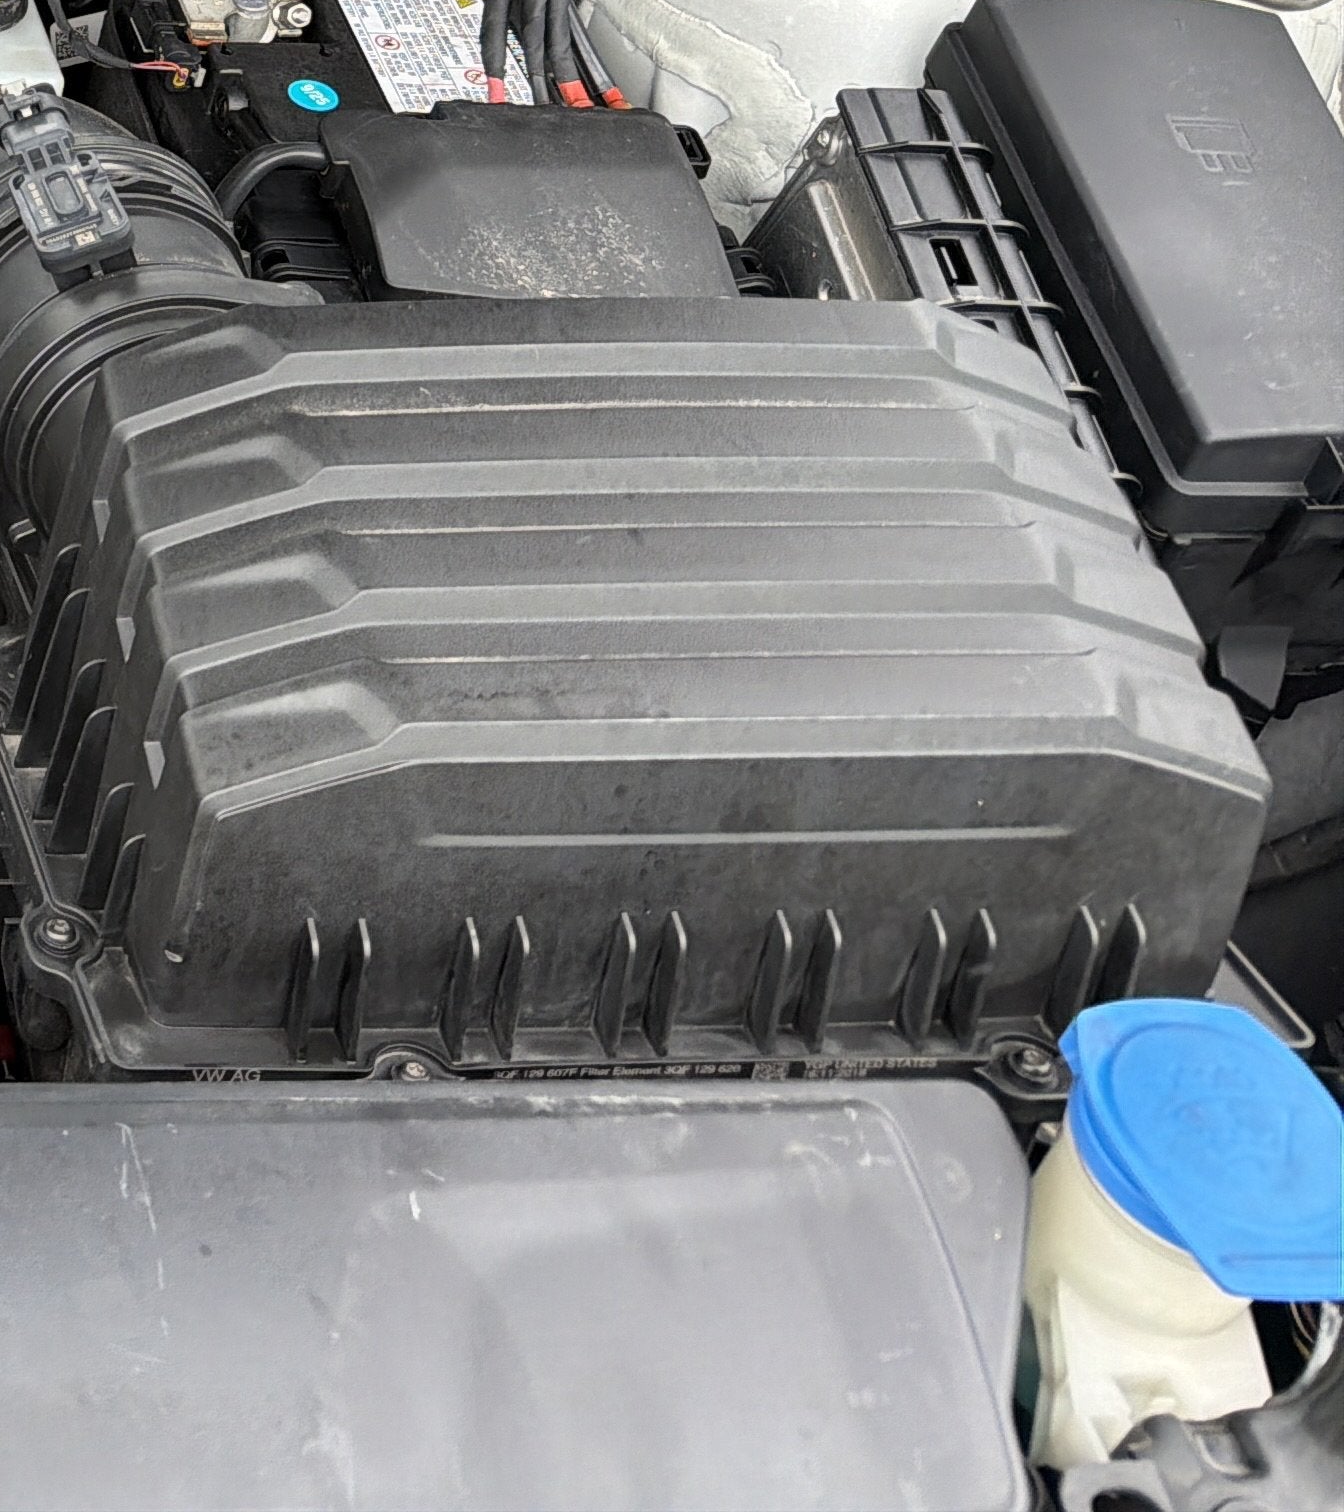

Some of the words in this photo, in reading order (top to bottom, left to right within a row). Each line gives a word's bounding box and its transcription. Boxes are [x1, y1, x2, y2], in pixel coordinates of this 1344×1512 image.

[300, 83, 331, 106] 9/25
[192, 1068, 226, 1082] VW
[230, 1068, 261, 1082] AG
[579, 1066, 611, 1077] Filter
[612, 1064, 662, 1076] Element
